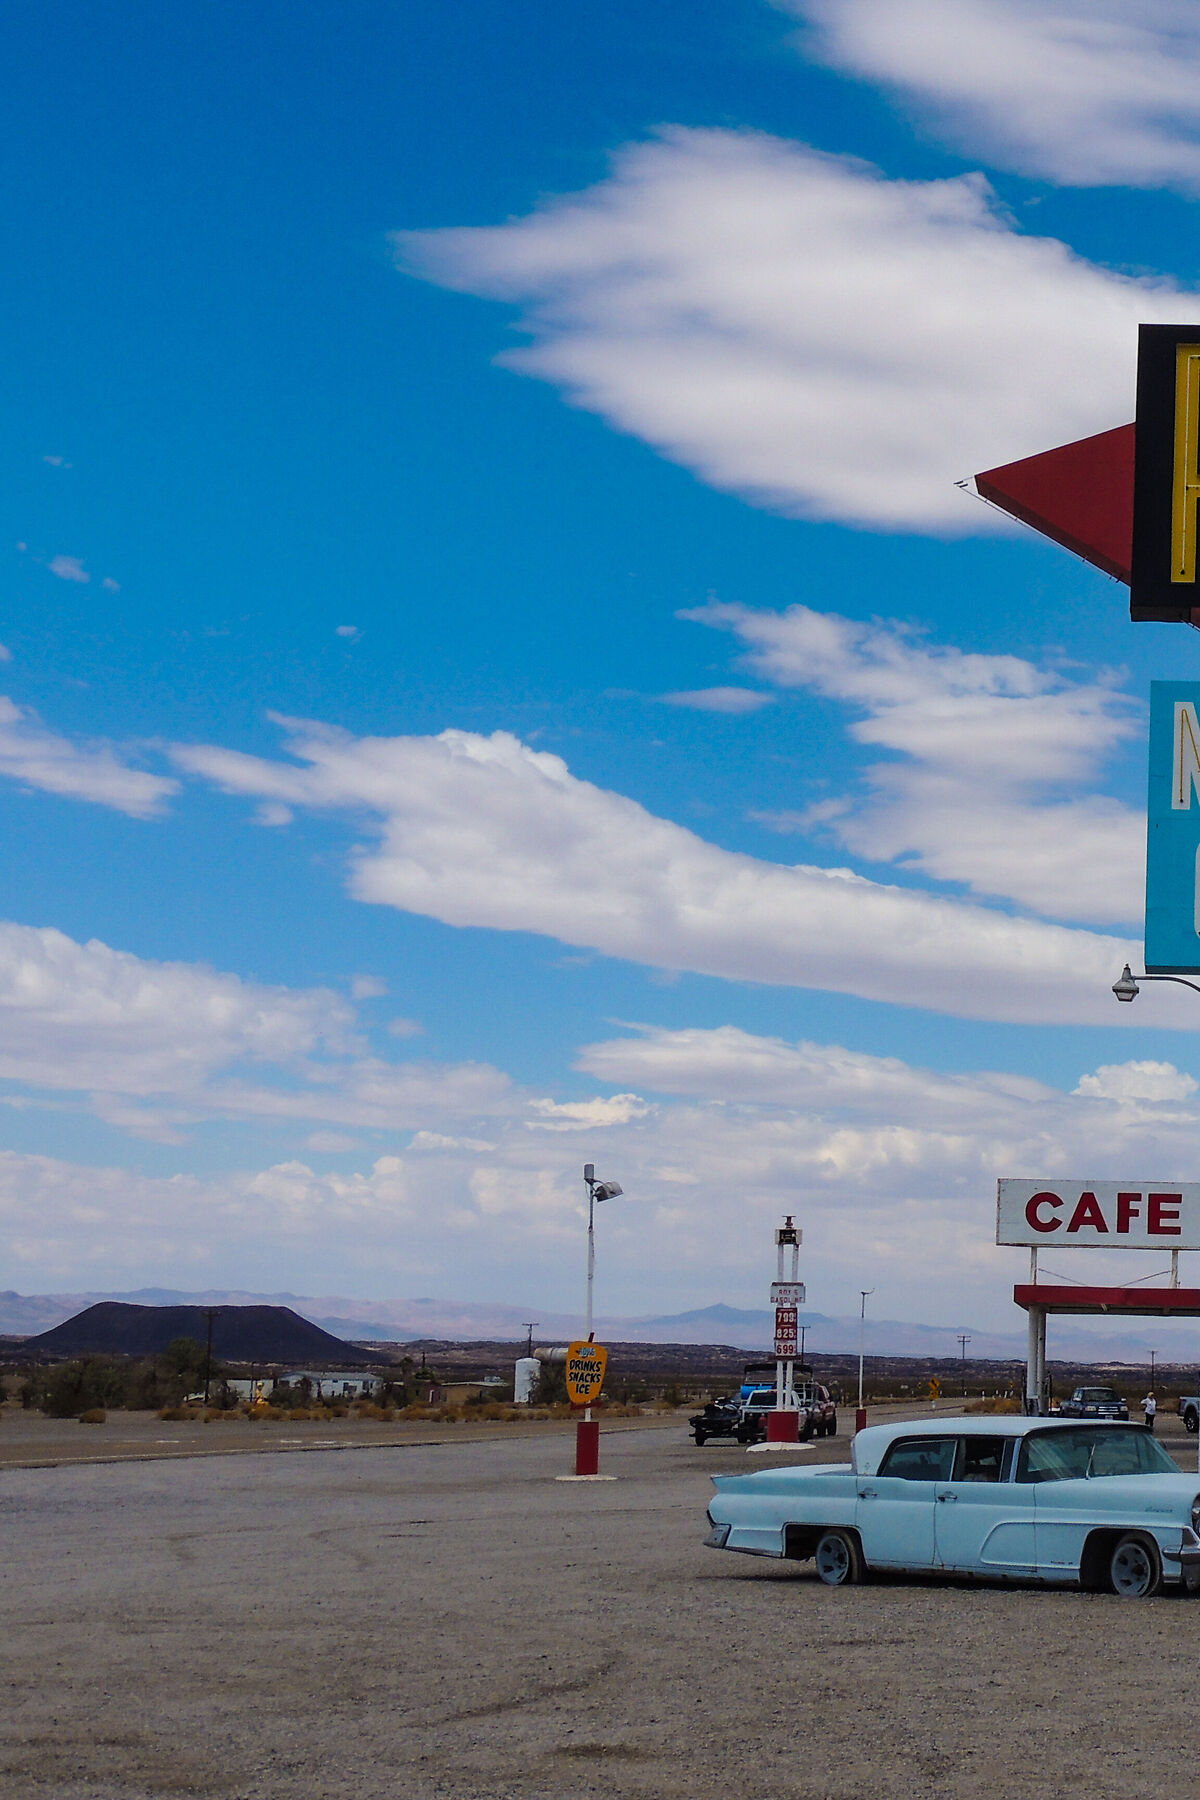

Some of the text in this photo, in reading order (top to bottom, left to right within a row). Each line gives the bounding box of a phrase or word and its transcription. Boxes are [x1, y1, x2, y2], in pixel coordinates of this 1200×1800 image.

[1025, 1191, 1183, 1235] CAFE
[569, 1359, 603, 1372] DRINKS
[568, 1371, 602, 1383] SNACKS
[575, 1383, 591, 1394] ICE
